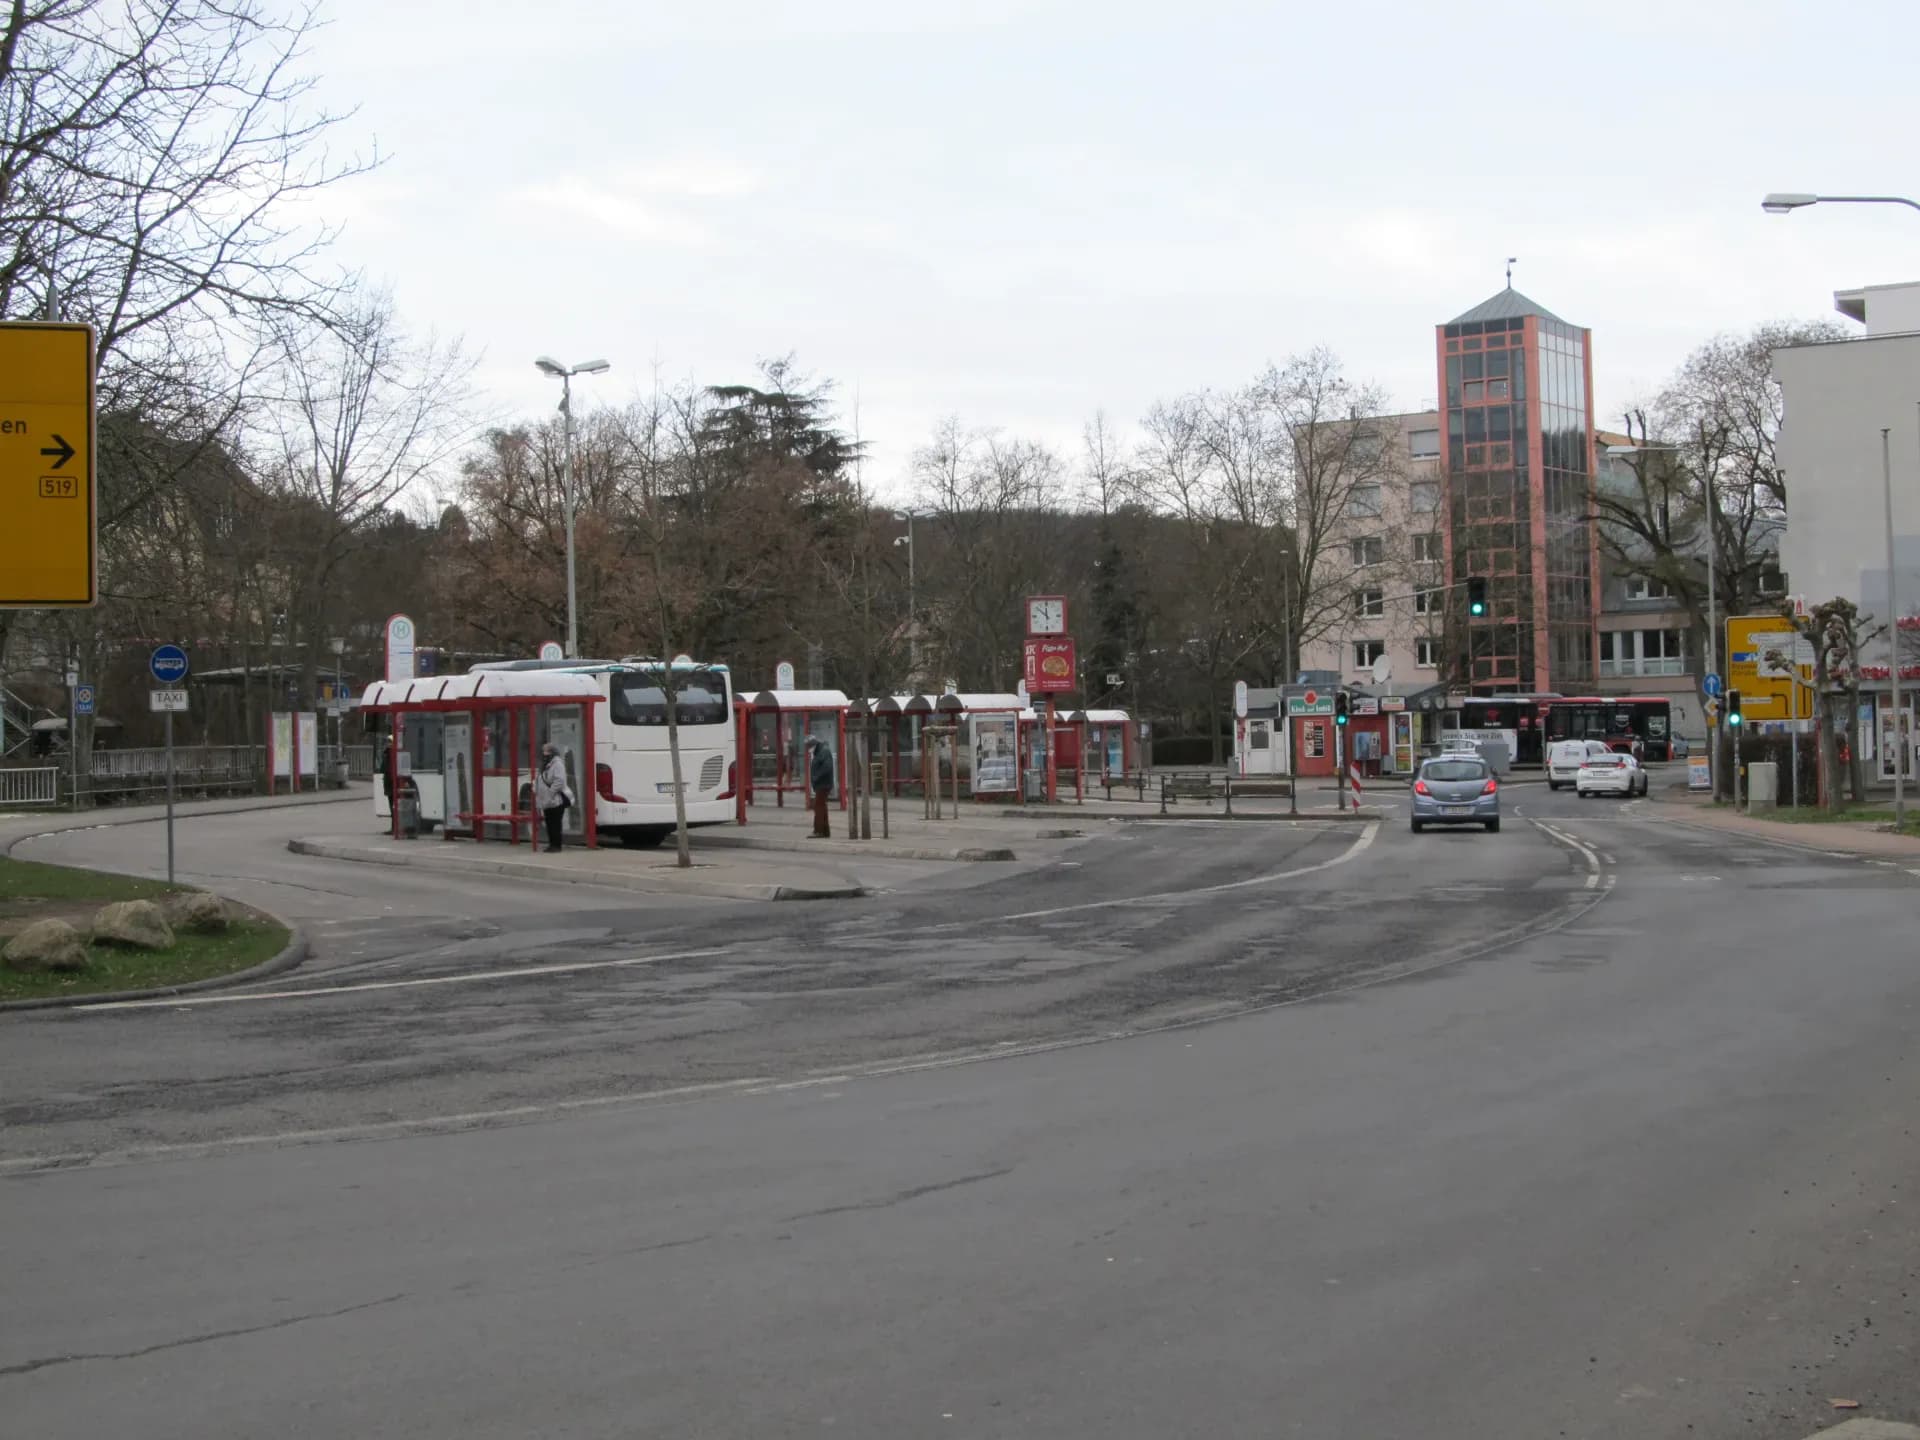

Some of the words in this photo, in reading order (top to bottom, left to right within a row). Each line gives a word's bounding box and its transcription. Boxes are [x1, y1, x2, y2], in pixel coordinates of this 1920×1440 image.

[2, 420, 27, 434] en
[45, 480, 72, 493] 519
[154, 692, 184, 703] TAXI
